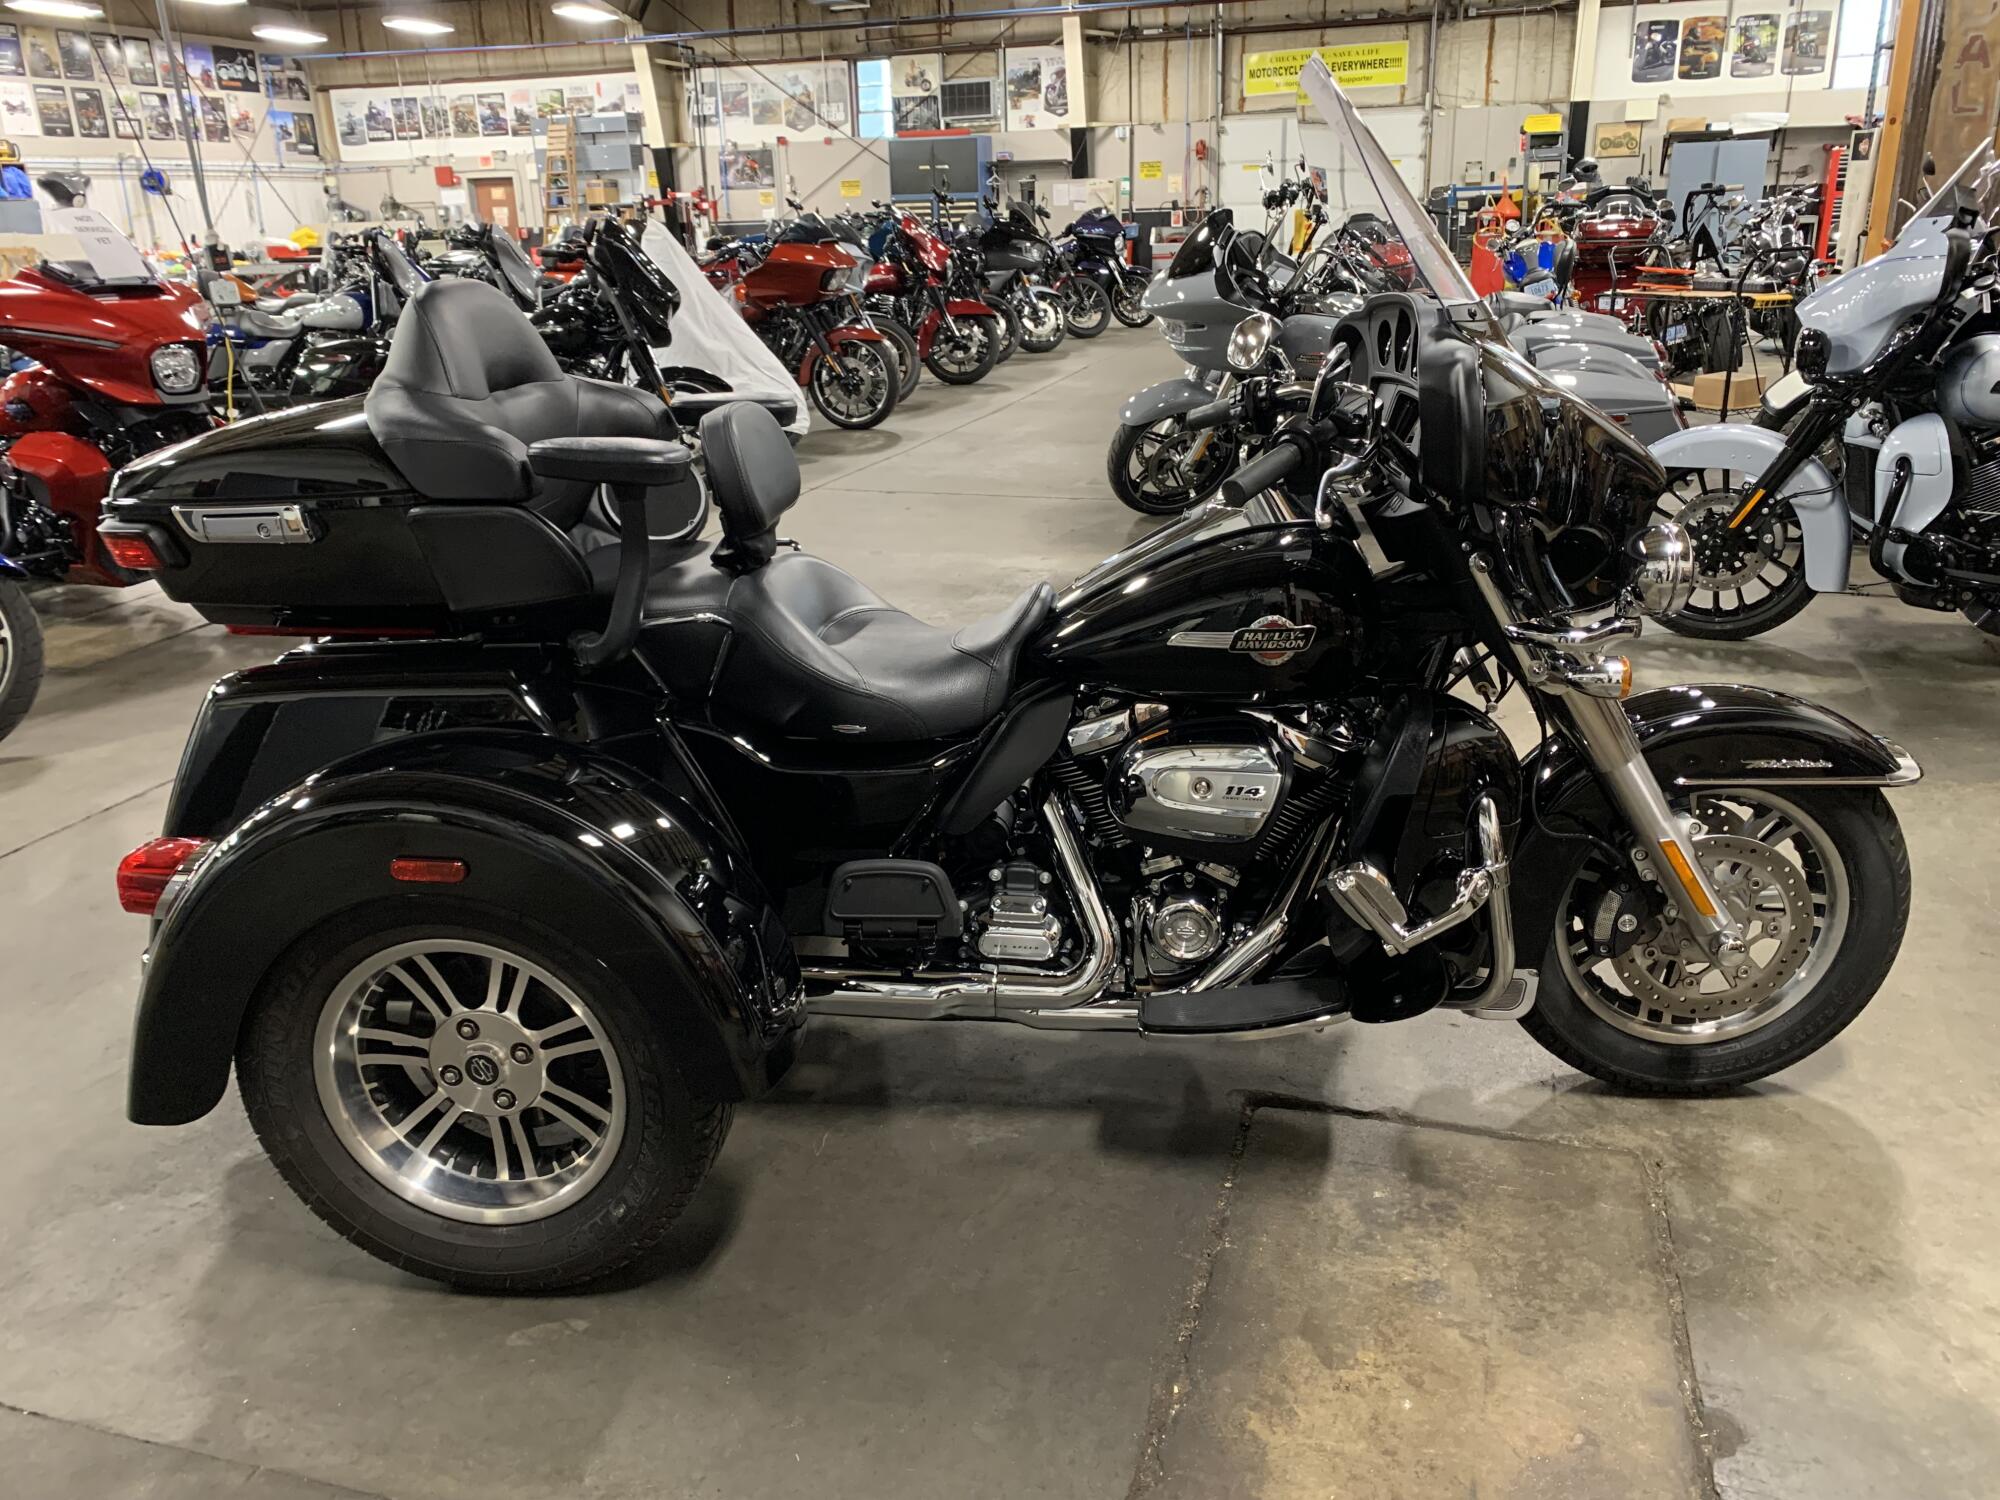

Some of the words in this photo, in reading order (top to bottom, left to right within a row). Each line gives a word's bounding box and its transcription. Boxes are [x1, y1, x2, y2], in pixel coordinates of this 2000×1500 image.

[1332, 50, 1351, 58] SAVE
[1362, 48, 1380, 56] LIFE
[1249, 64, 1305, 79] MOTORCYCL
[1338, 75, 1373, 84] Supporter
[95, 237, 112, 245] YET
[1242, 631, 1305, 641] HARLEY-
[1235, 639, 1306, 649] DAVIDSON
[1225, 785, 1263, 797] 114
